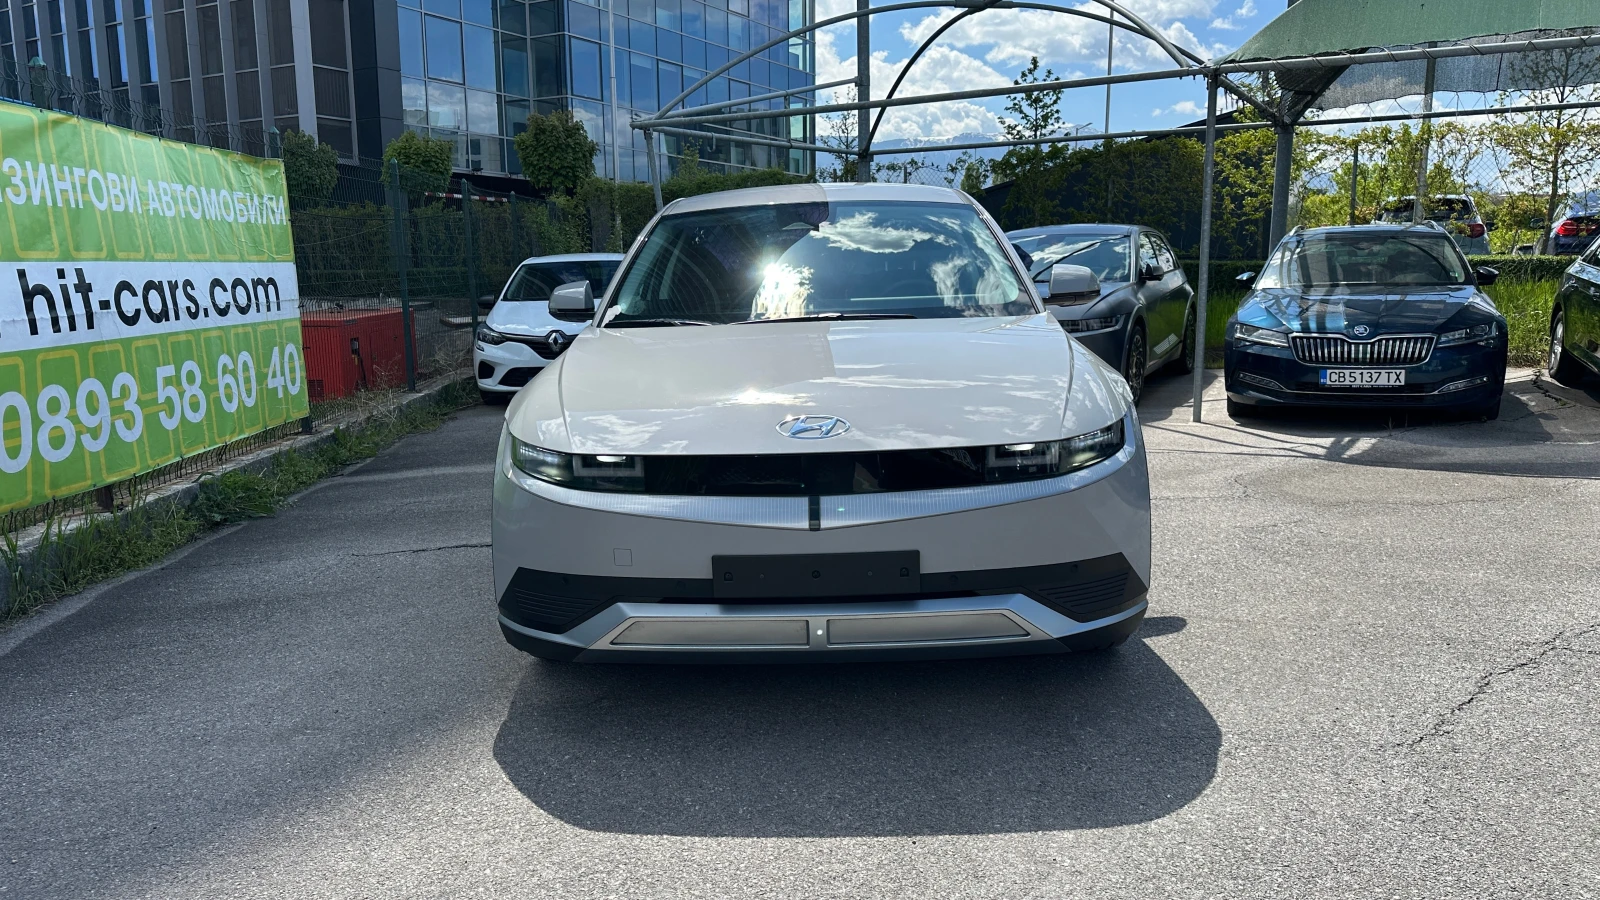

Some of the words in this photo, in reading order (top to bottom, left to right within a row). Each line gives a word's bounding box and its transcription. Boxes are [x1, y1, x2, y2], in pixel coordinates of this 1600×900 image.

[0, 157, 142, 214] ЗИНГОВИ
[147, 179, 287, 226] АВТОМОБИЛИ
[16, 267, 281, 336] hit-cars.com
[0, 371, 143, 474] 0893
[156, 360, 207, 431] 58
[217, 350, 257, 413] 60
[267, 342, 301, 399] 40
